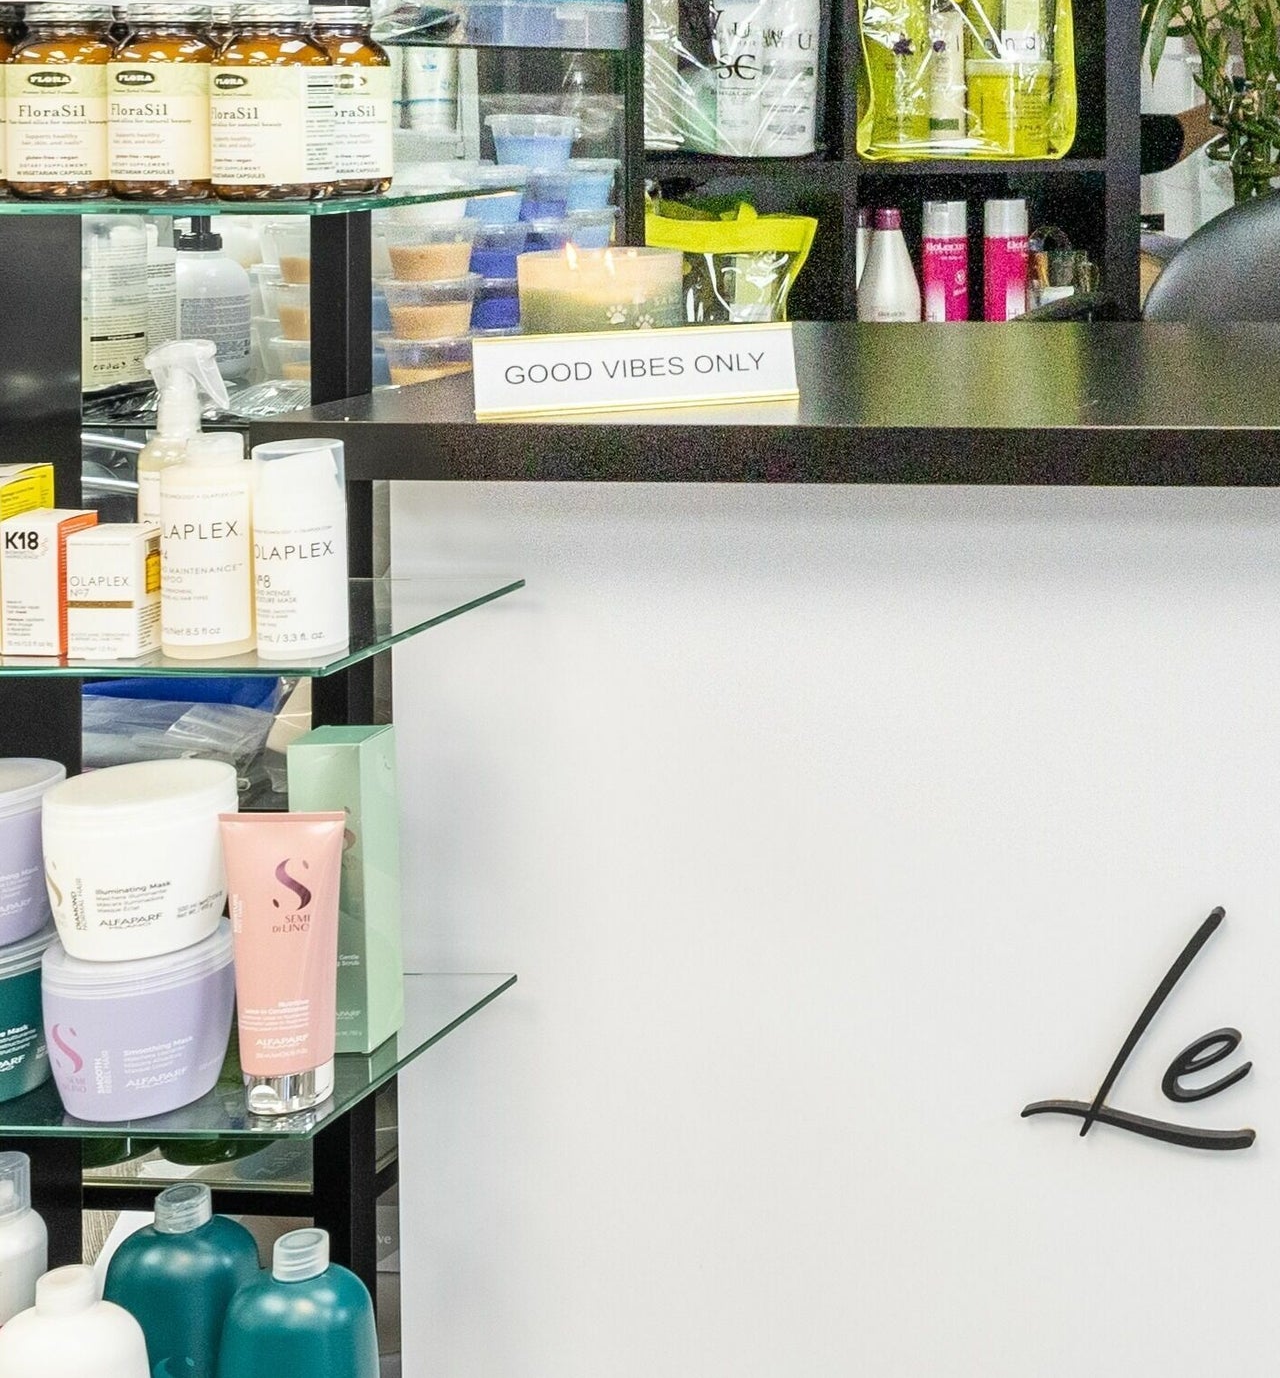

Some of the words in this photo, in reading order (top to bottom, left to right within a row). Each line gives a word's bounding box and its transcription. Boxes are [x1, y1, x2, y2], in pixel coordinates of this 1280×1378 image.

[30, 76, 70, 84] FLORA
[19, 105, 86, 117] FloraSil
[111, 103, 167, 116] FloraSil
[505, 362, 592, 384] GOOD
[602, 356, 684, 379] VIBES
[695, 352, 764, 375] ONLY
[163, 520, 239, 540] LAPLEX
[5, 531, 39, 550] K18
[69, 575, 130, 587] OLAPLEX
[283, 633, 297, 643] 3.3
[95, 885, 147, 895] Illuminating
[149, 881, 171, 889] Mask
[99, 912, 163, 927] ALFAPARF
[284, 914, 311, 924] SEMI
[1020, 905, 1257, 1151] Le
[123, 1042, 172, 1057] Smoothing
[173, 1035, 194, 1047] Mask
[256, 1033, 310, 1046] ALFAPARF
[126, 1066, 188, 1088] ALFAPARF
